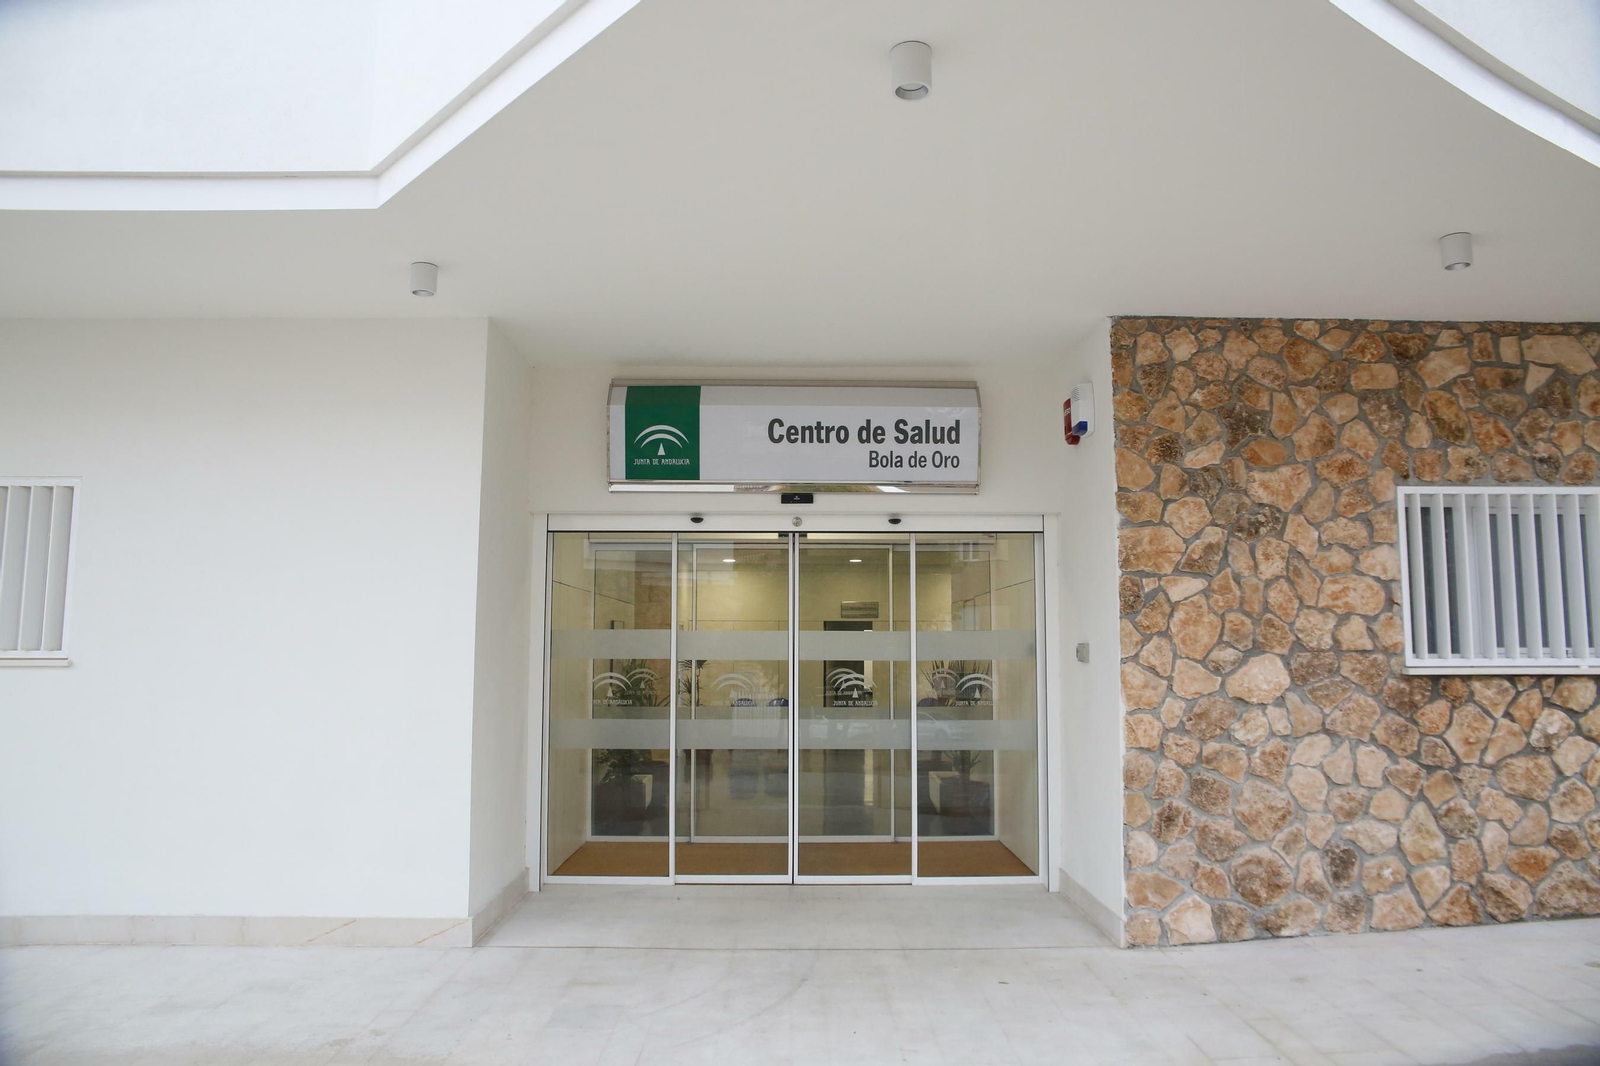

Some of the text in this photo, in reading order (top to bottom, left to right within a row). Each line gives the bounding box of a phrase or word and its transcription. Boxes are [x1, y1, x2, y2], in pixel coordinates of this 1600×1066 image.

[768, 418, 960, 444] Centro de Salud
[869, 451, 960, 469] Bola de Oro
